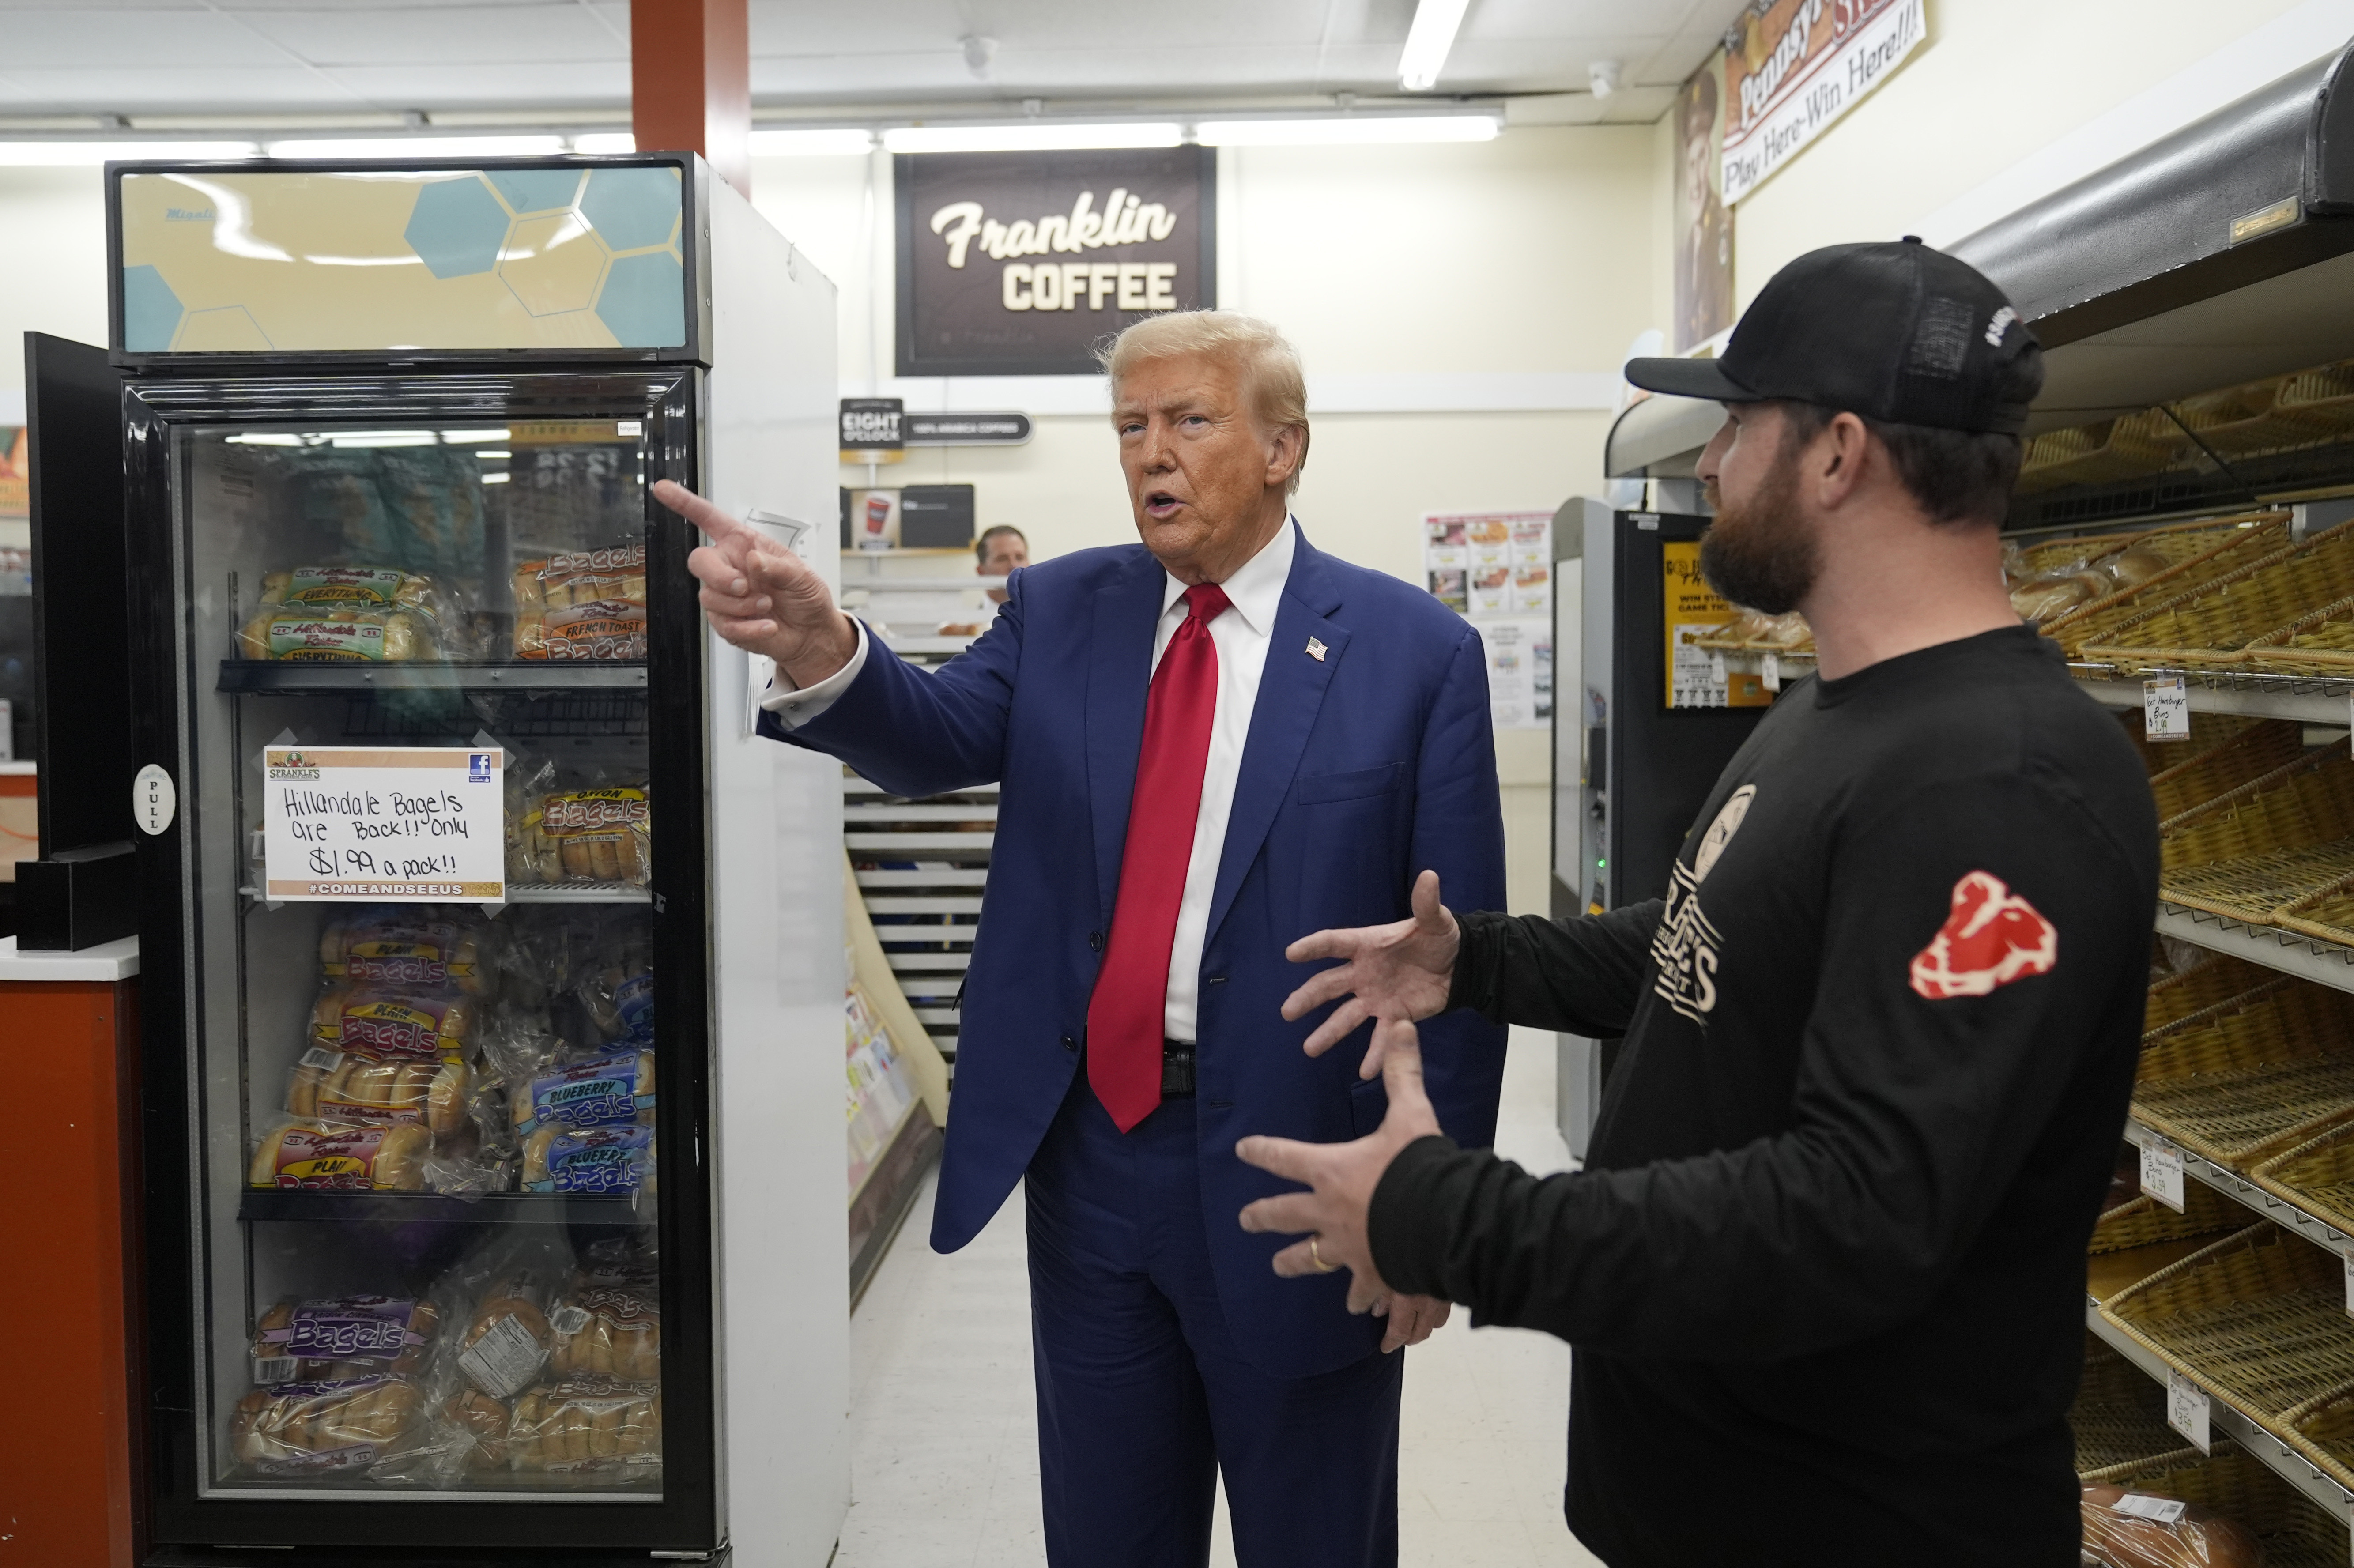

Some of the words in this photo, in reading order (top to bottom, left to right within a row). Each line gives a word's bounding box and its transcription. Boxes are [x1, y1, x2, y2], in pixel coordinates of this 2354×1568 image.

[1724, 152, 1760, 194] Play
[1764, 82, 1841, 167] Here-Win
[930, 188, 1177, 268] Franklin
[1003, 262, 1177, 311] COFFEE
[842, 411, 902, 431] EIGHT
[843, 429, 900, 442] O'CLOCK
[545, 543, 645, 576] Bagels
[303, 588, 372, 600] EVERYTHING
[1678, 603, 1707, 612] GAME
[566, 622, 608, 637] FRENCH
[609, 622, 640, 632] TOAST
[2154, 706, 2169, 719] Buns
[2158, 694, 2186, 710] Hamburger
[270, 769, 320, 779] SPRANKLE'S
[149, 782, 158, 828] PULL
[577, 790, 623, 799] ONION
[284, 788, 380, 817] Hillandale
[389, 790, 463, 825] Bagels
[542, 799, 649, 829] Bagels
[292, 821, 327, 841] are
[352, 819, 419, 840] Back!!
[309, 847, 376, 877] $1.99
[384, 861, 397, 876] a
[403, 855, 456, 880] pack!!
[309, 883, 463, 895] #COMEANDSEEUS
[346, 954, 448, 984] Bagels
[373, 1003, 412, 1020] PLAIN
[339, 1015, 439, 1053] Bagels
[550, 1081, 616, 1103] BLUEBERRY
[533, 1093, 638, 1126] Bagels
[286, 1319, 407, 1353] Bagels
